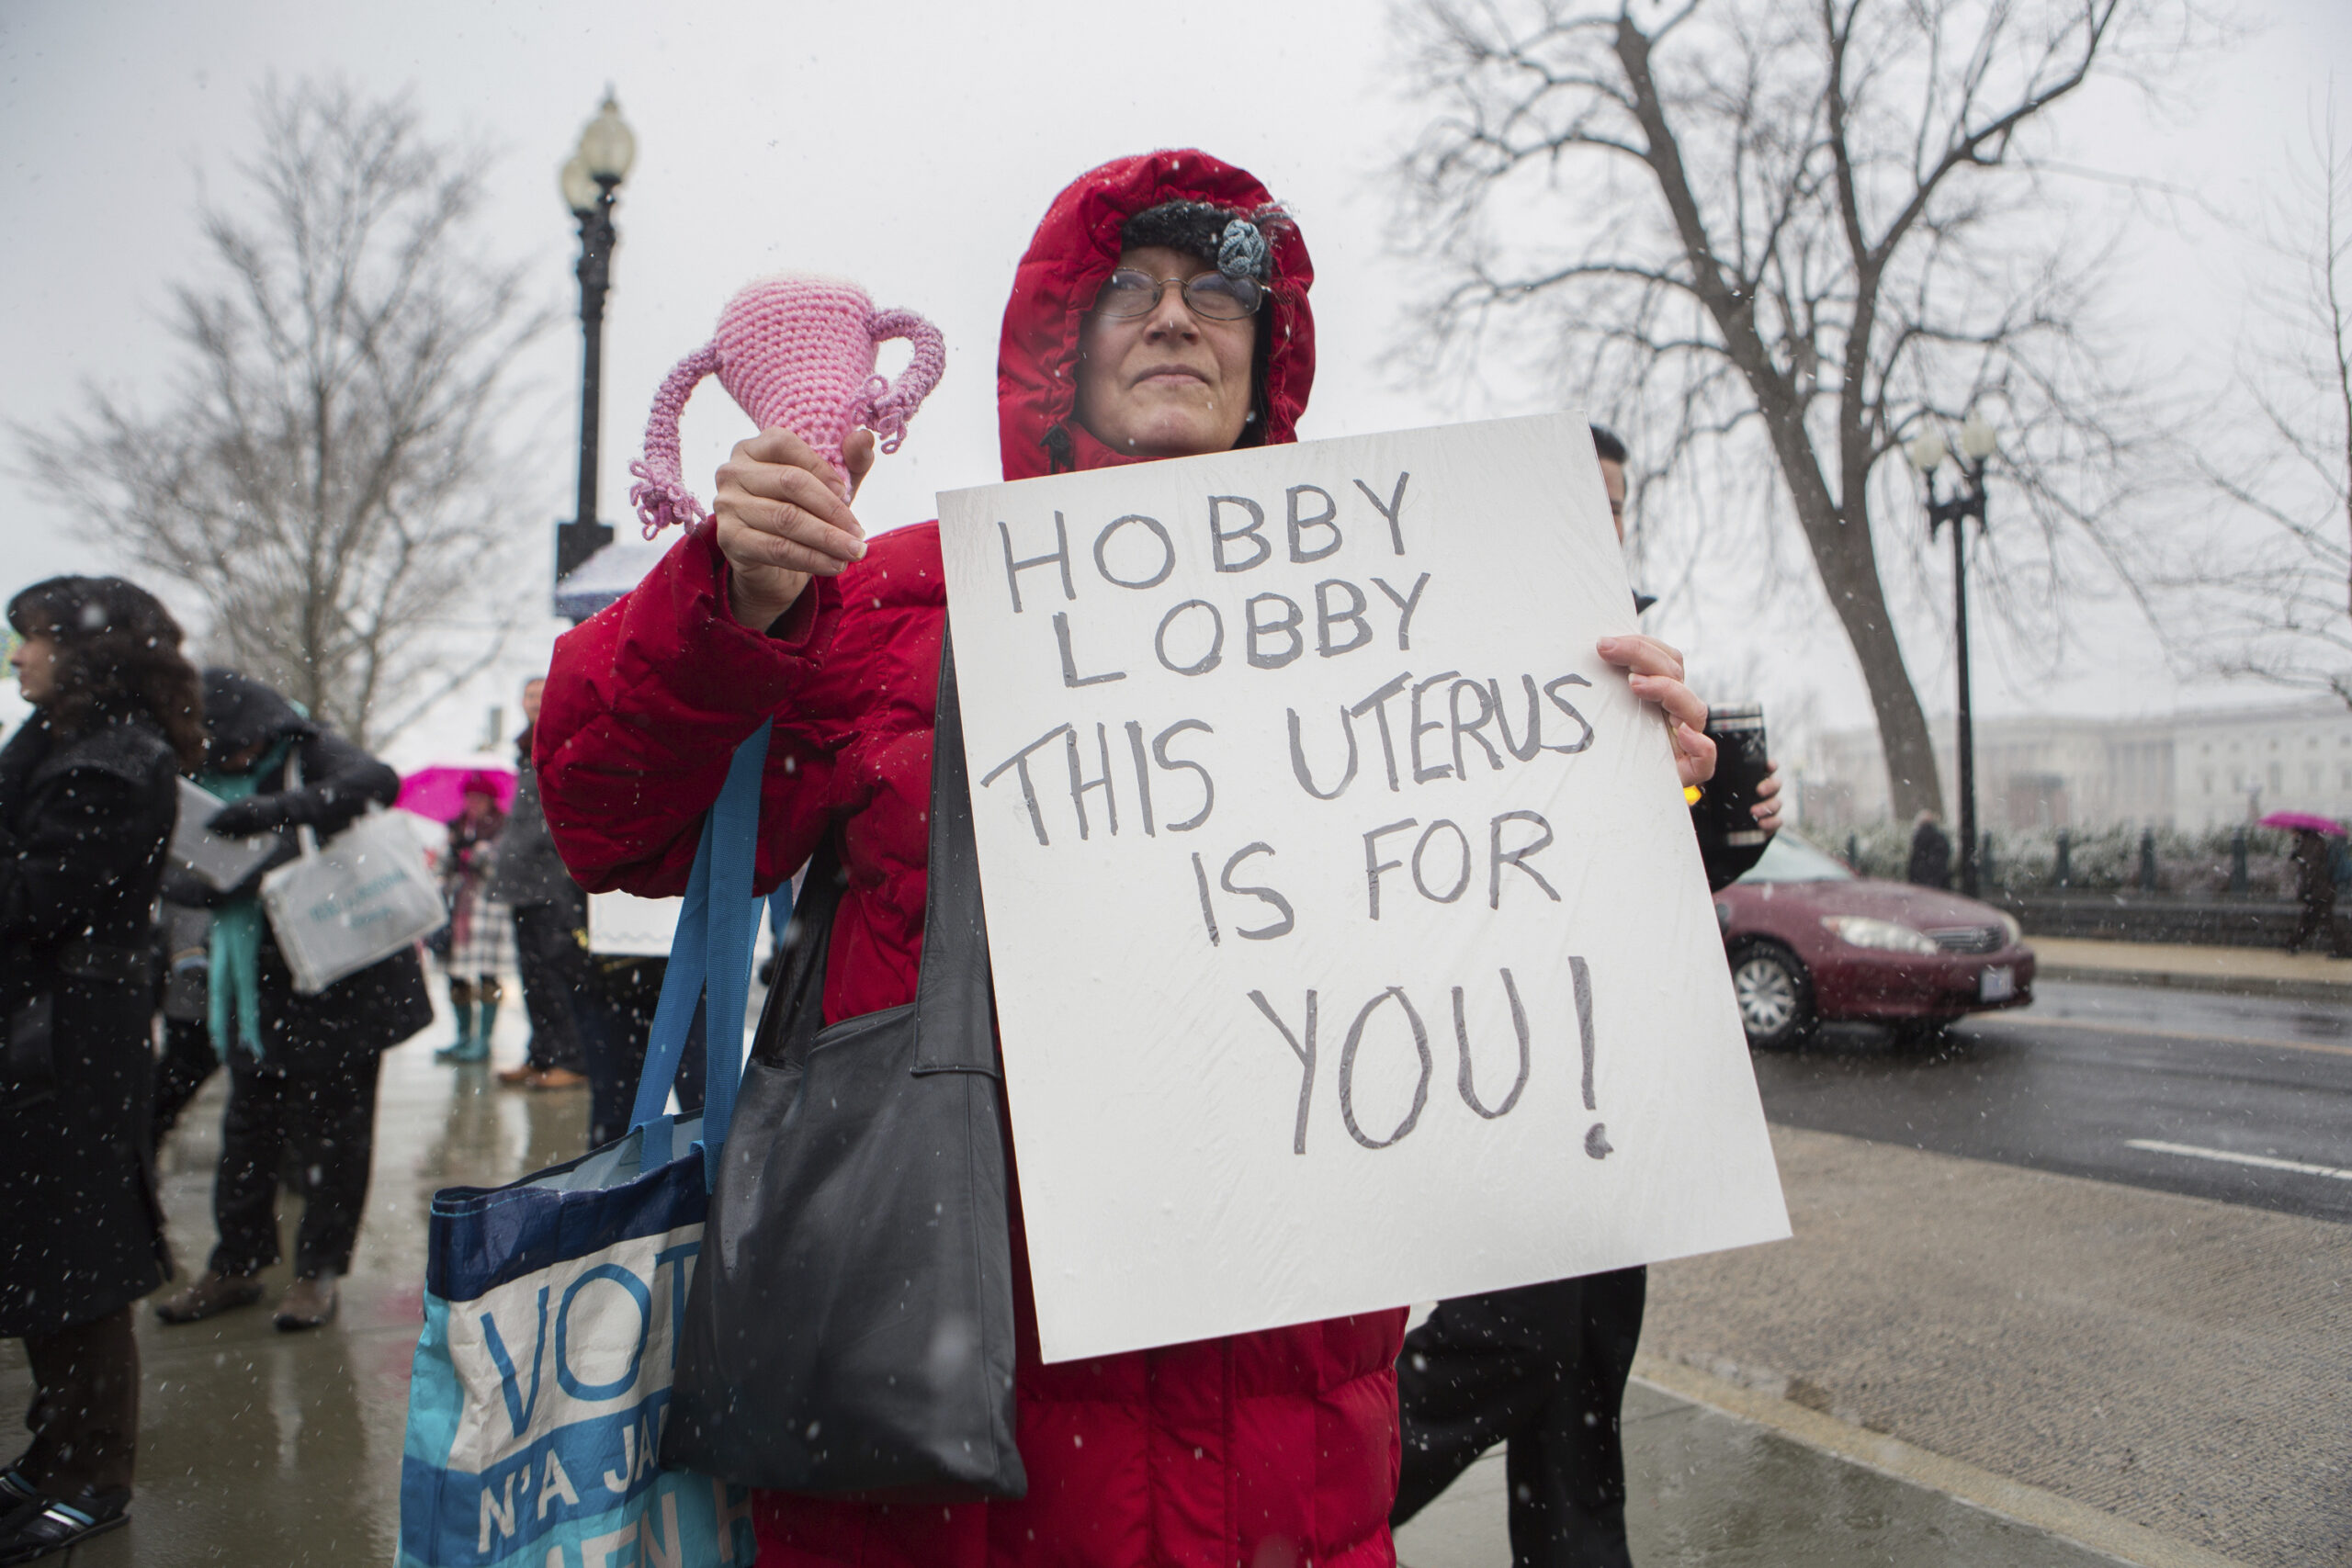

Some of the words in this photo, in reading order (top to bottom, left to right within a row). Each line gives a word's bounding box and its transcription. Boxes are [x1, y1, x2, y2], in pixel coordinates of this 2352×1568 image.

[998, 471, 1410, 614] HOBBY
[1052, 572, 1431, 689] LOBBY
[981, 718, 1215, 846] THIS
[1285, 671, 1595, 801] UTERUS
[1192, 841, 1295, 947] IS
[1363, 810, 1561, 921] FOR
[1247, 956, 1614, 1160] YOU!
